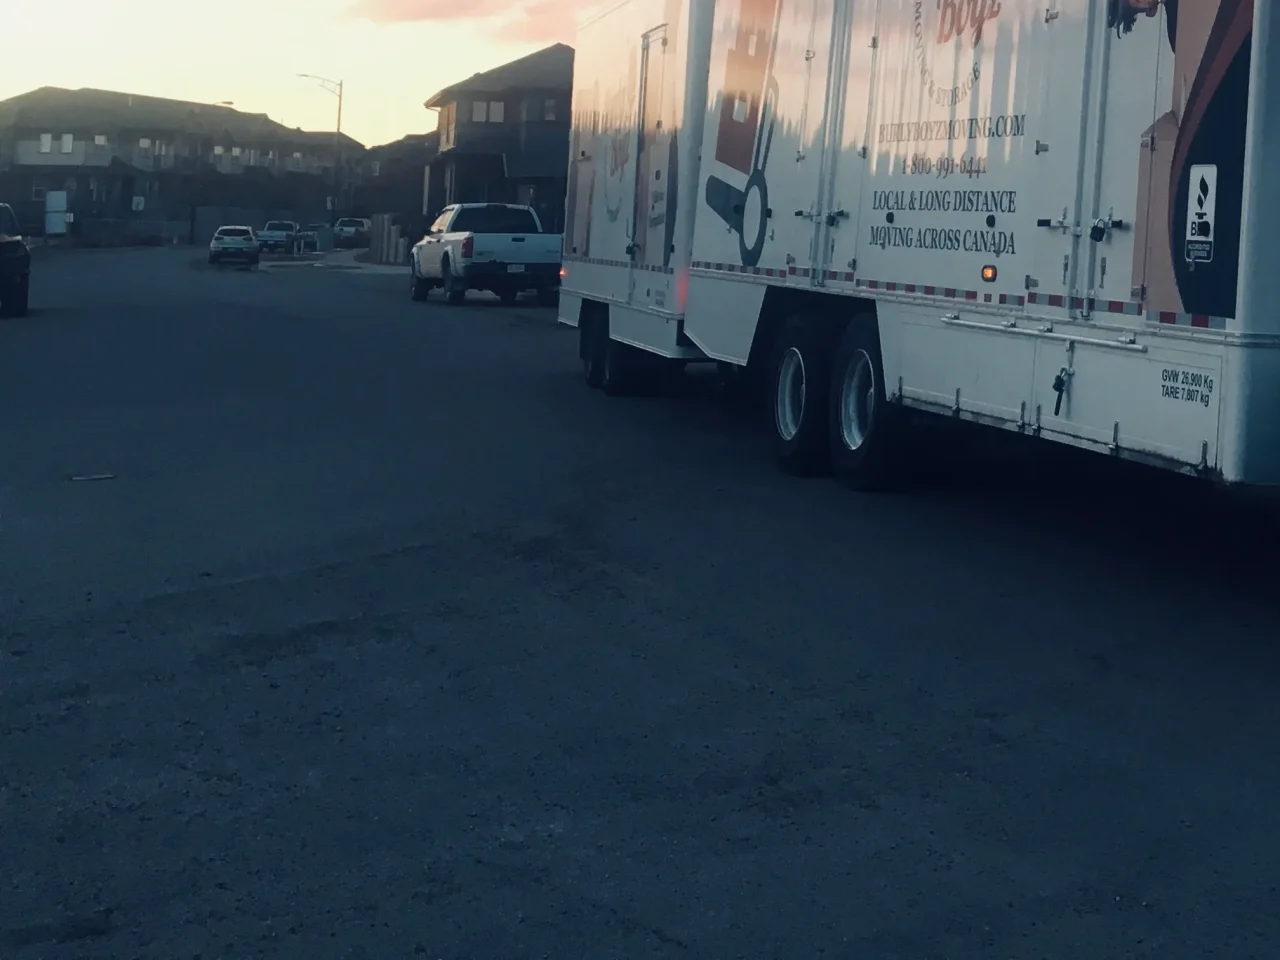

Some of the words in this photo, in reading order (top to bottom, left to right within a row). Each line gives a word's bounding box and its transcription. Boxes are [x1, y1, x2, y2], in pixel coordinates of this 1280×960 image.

[914, 1, 931, 86] MOVING
[935, 61, 980, 107] STORAGE
[878, 115, 1026, 143] BURLYBOYZMOVING.COM
[872, 190, 907, 210] LOCAL
[908, 191, 917, 211] &
[918, 190, 950, 211] LONG
[953, 190, 1017, 213] DISTANCE
[869, 226, 913, 248] MOVING
[915, 228, 961, 251] ACROSS
[963, 229, 1016, 254] CANADA
[1161, 385, 1180, 399] TARE
[1162, 369, 1180, 383] GVW
[1203, 375, 1213, 393] Kg
